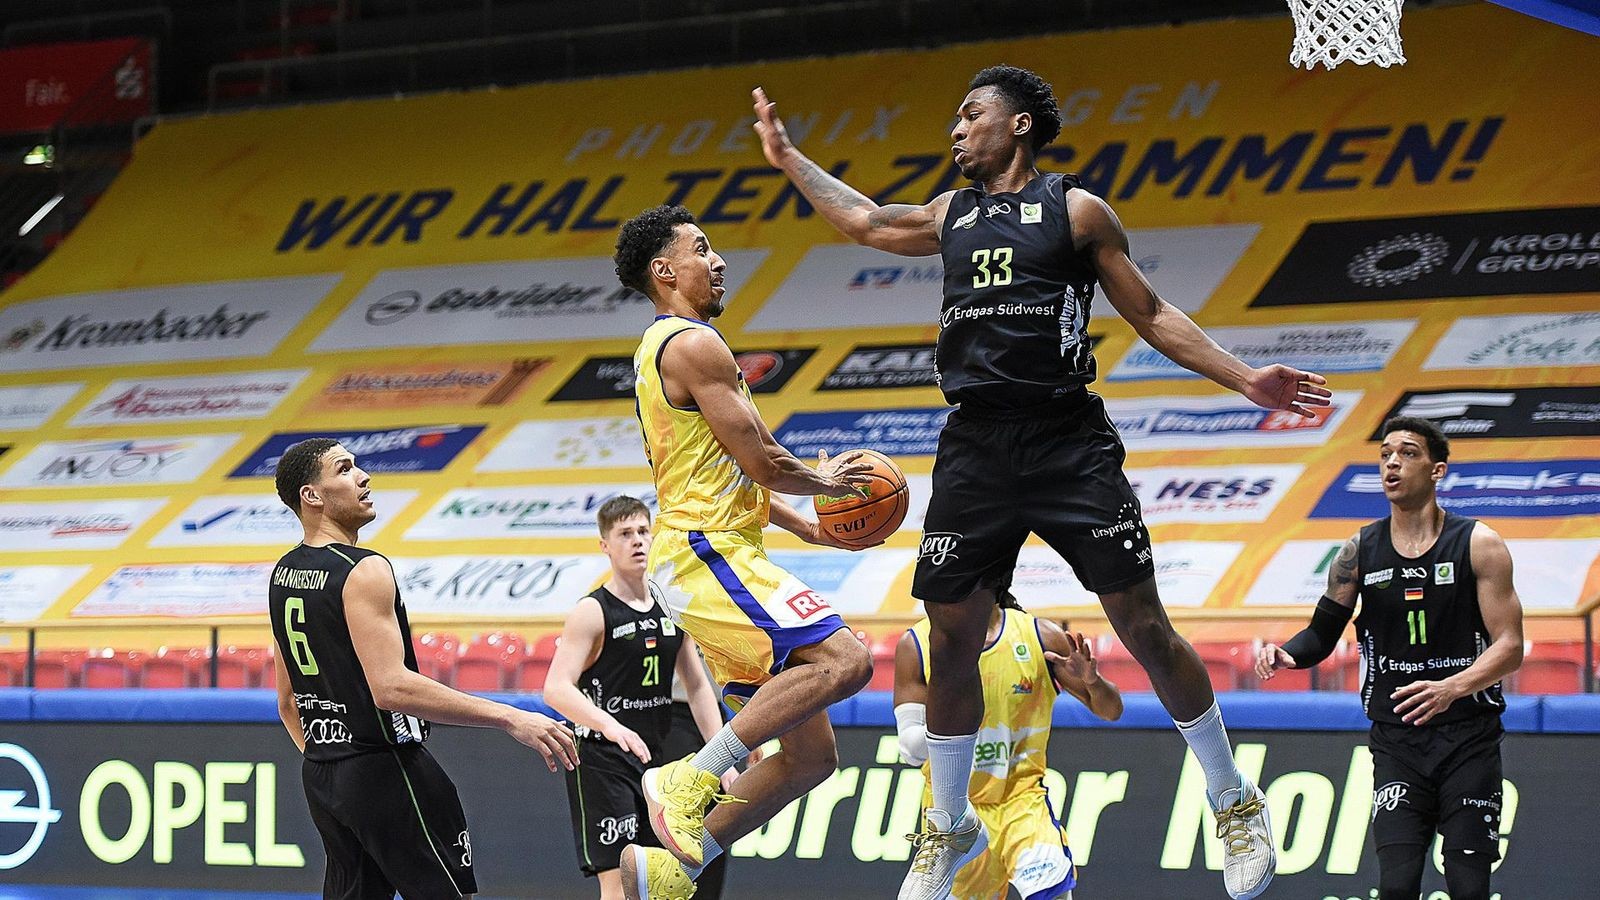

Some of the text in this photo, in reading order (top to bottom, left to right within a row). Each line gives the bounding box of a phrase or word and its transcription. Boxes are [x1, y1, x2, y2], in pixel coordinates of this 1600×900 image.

[566, 80, 1220, 163] PHOENIX GEN
[276, 190, 456, 253] WIR
[971, 247, 1014, 290] 33
[1476, 251, 1600, 274] GRUPP
[426, 283, 605, 313] Gebrüder
[954, 305, 994, 321] Erdgas
[996, 303, 1055, 317] Südwest
[34, 303, 271, 351] Krombacher
[37, 452, 190, 480] INJOY
[1156, 477, 1275, 500] HESS
[833, 517, 867, 534] EVO
[1092, 518, 1136, 540] Urspring
[273, 565, 330, 591] HANKERSON
[435, 557, 580, 601] KIPOS
[284, 596, 320, 676] 6
[1407, 610, 1427, 645] 11
[641, 654, 660, 686] 21
[1389, 655, 1474, 674] Erdgas Südwes
[622, 699, 653, 710] Erdgas
[79, 759, 305, 867] OPEL
[1160, 743, 1519, 877] Nol
[599, 814, 638, 846] Berg
